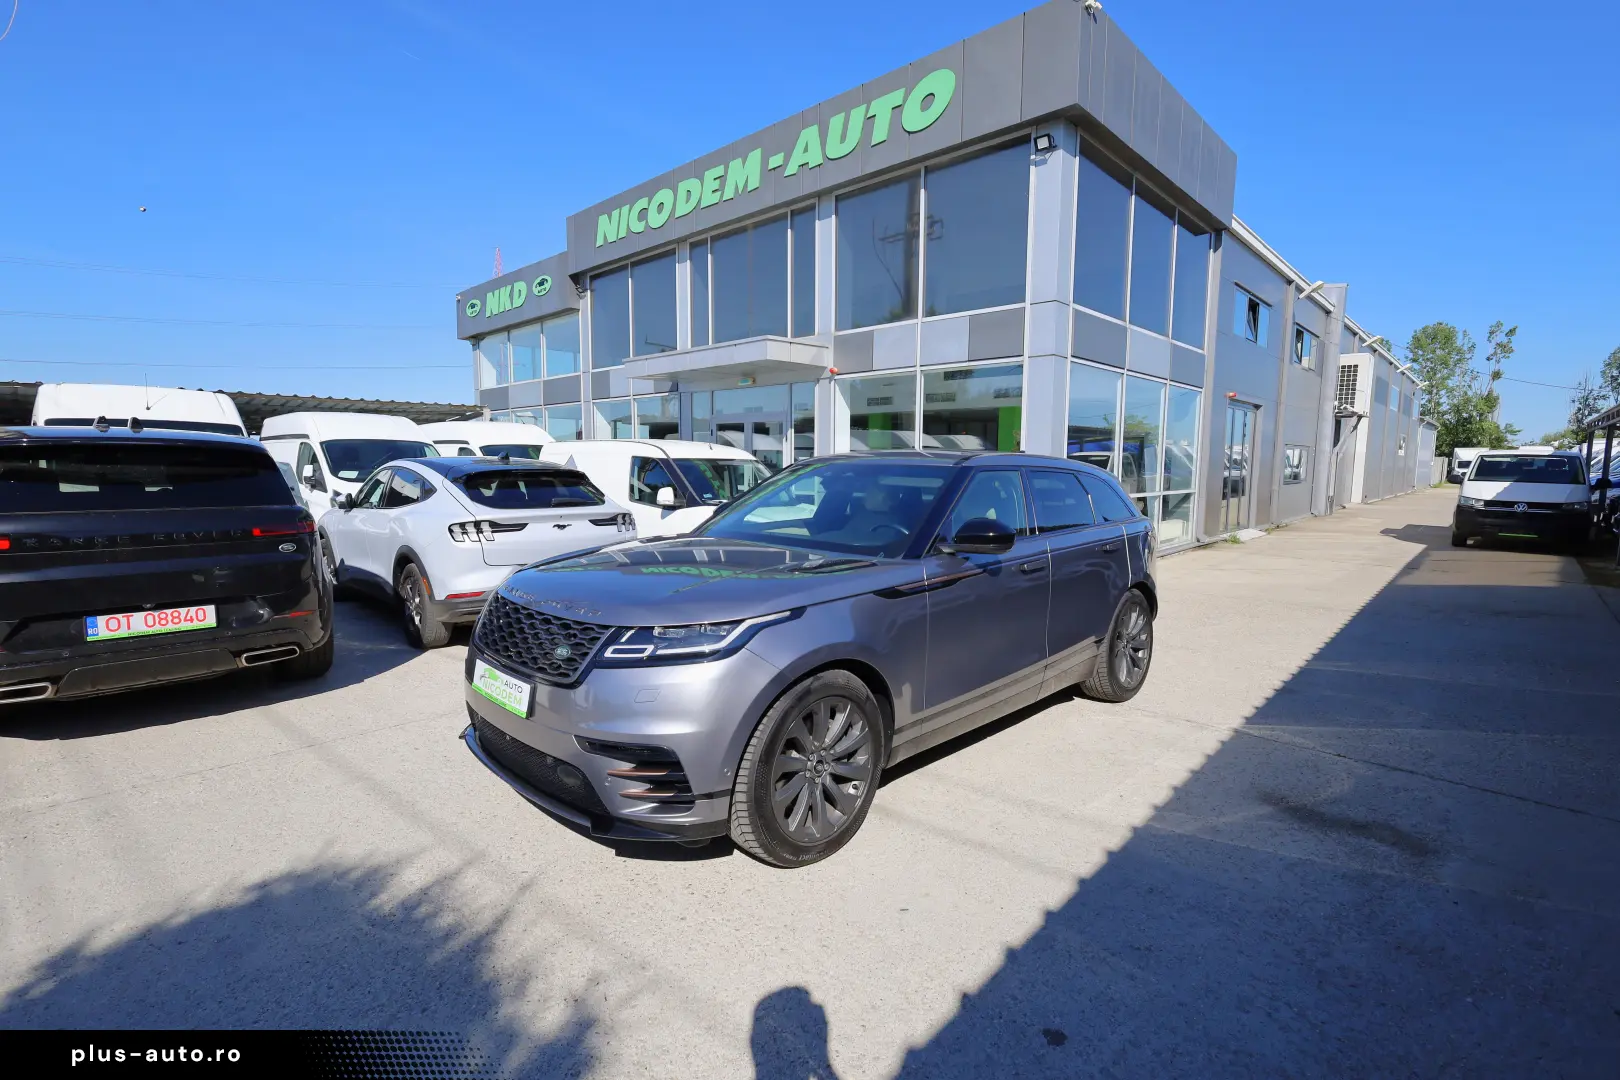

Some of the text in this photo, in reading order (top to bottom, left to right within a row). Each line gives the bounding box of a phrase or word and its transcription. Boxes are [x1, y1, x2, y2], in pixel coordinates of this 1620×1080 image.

[486, 281, 528, 317] NKD
[88, 627, 98, 635] RO
[105, 608, 207, 632] OT 08840
[481, 678, 522, 706] NICODEM
[503, 680, 523, 694] AUTO
